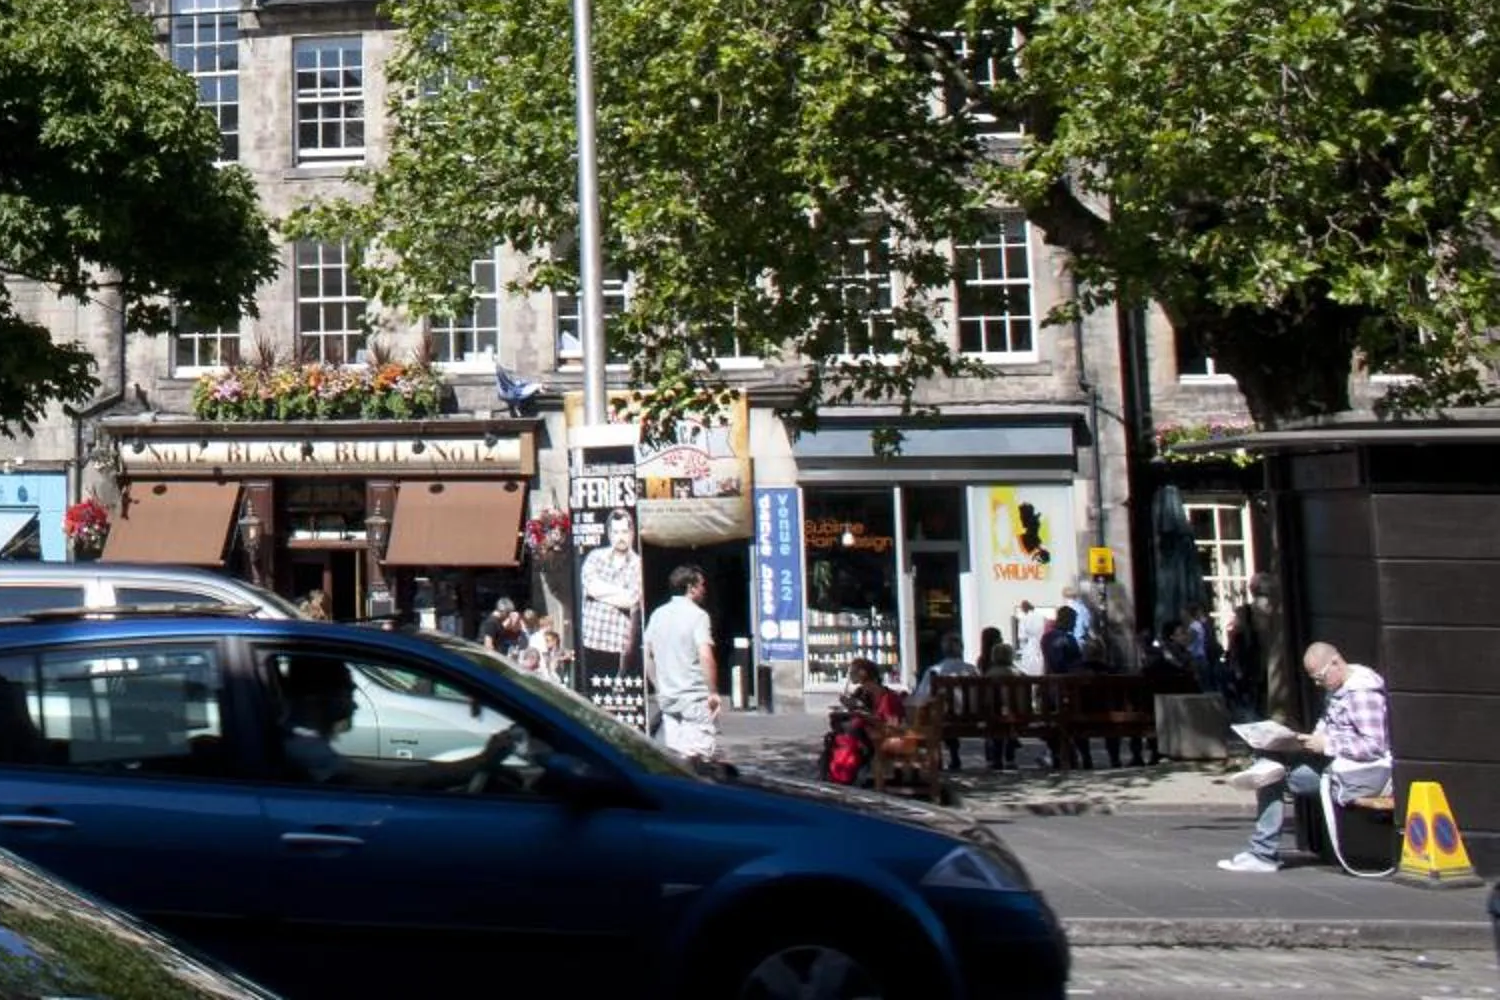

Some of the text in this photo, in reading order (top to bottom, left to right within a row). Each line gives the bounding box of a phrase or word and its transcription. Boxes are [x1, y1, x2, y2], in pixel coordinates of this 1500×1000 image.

[227, 441, 319, 463] BLACK
[334, 441, 410, 463] BULL
[777, 494, 793, 601] venue 22
